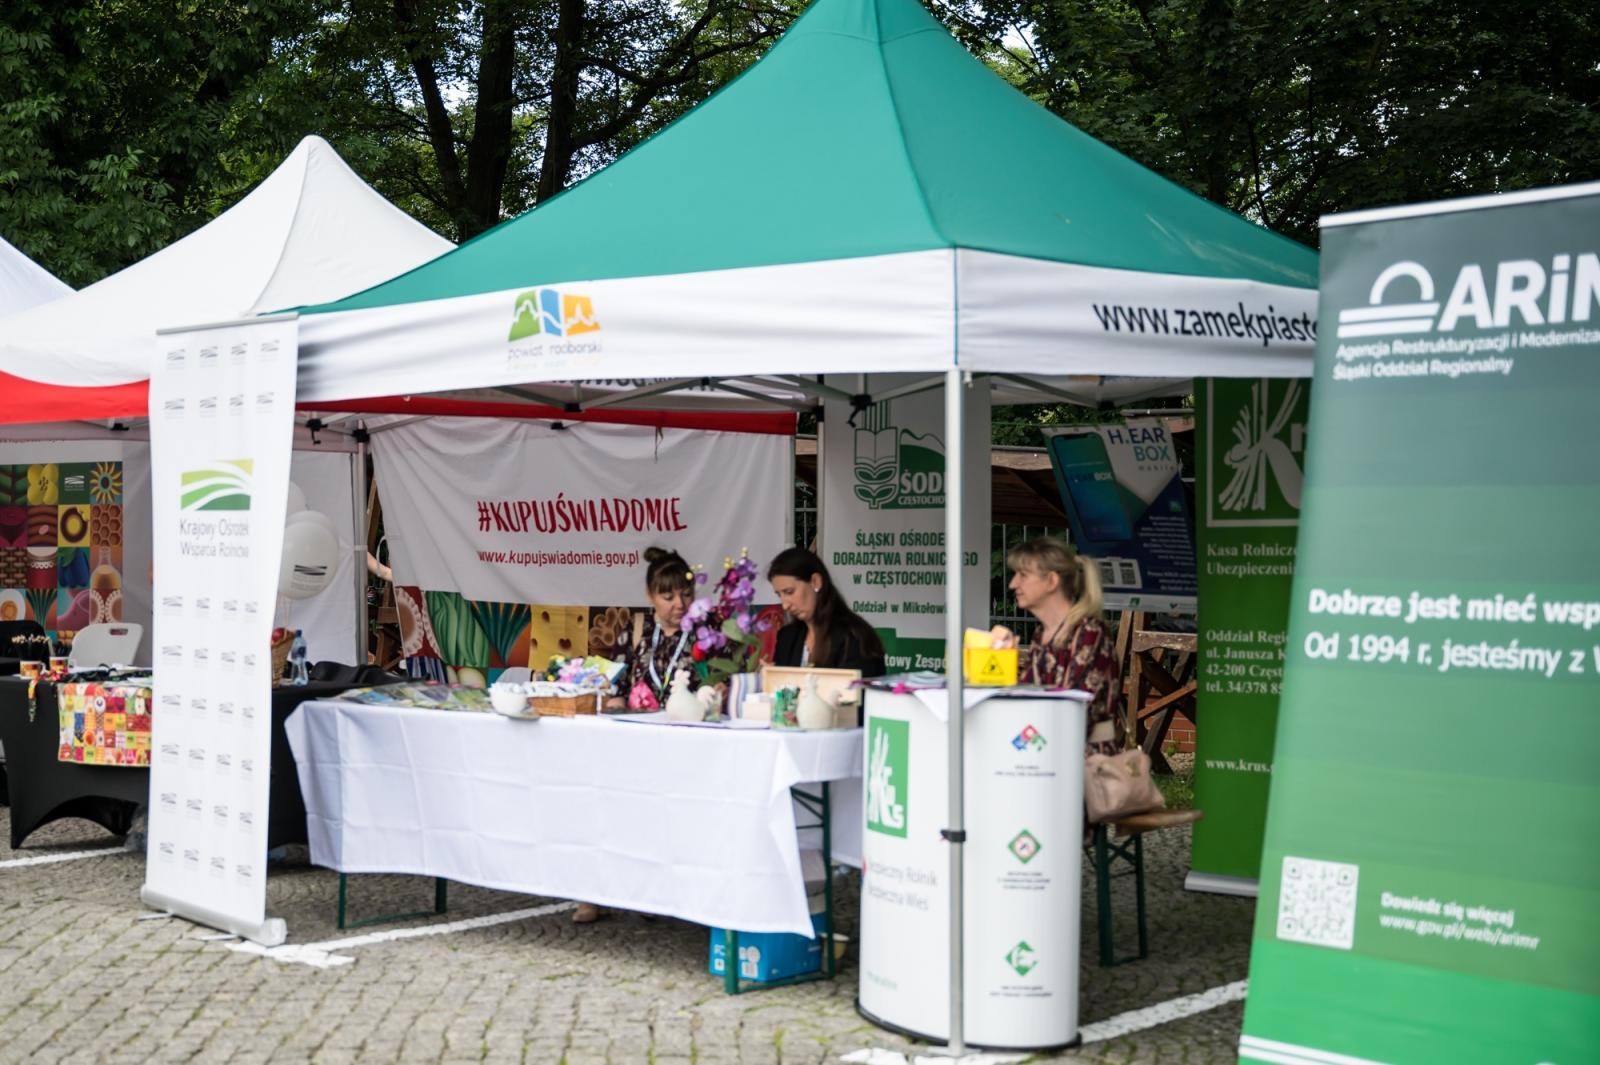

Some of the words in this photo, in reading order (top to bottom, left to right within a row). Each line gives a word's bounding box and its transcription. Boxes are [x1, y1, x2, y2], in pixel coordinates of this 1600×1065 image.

[1336, 340, 1390, 362] Agencja
[1430, 355, 1513, 378] Regionalny
[1107, 427, 1167, 445] H.EAR
[1133, 445, 1171, 461] BOX
[900, 469, 946, 494] ŚOD
[898, 496, 946, 506] CZĘSTOCHO
[477, 492, 688, 534] #KUPUJŚWIADOMIE
[855, 529, 895, 549] ŚLĄSKI
[900, 529, 946, 547] OŚRODE
[478, 550, 639, 567] www.kupujswiadomie.gov.pl
[833, 552, 901, 566] DORADZTWA
[905, 552, 979, 566] ROLNICGO
[1207, 544, 1238, 557] Kasa
[865, 571, 947, 588] CZĘSTOCHOWI
[853, 600, 887, 613] Oddział
[891, 603, 899, 613] w
[903, 601, 947, 614] Mikołowi
[1309, 588, 1402, 616] Dobrze
[1405, 591, 1460, 623] jest
[1466, 593, 1537, 622] mieć
[1206, 647, 1220, 659] ul.
[1224, 647, 1274, 660] Janusza
[1304, 632, 1339, 659] Od
[1348, 633, 1410, 663] 1994
[1417, 642, 1432, 665] r.
[1438, 639, 1562, 678] jesteśmy
[1568, 650, 1585, 673] z
[884, 655, 912, 670] towy
[1206, 664, 1246, 676] 42-200
[1249, 665, 1283, 680] Częst
[1206, 680, 1223, 692] tel.
[1226, 681, 1267, 694] 34/378
[1381, 891, 1441, 915] Dowiedz
[1443, 901, 1464, 920] się
